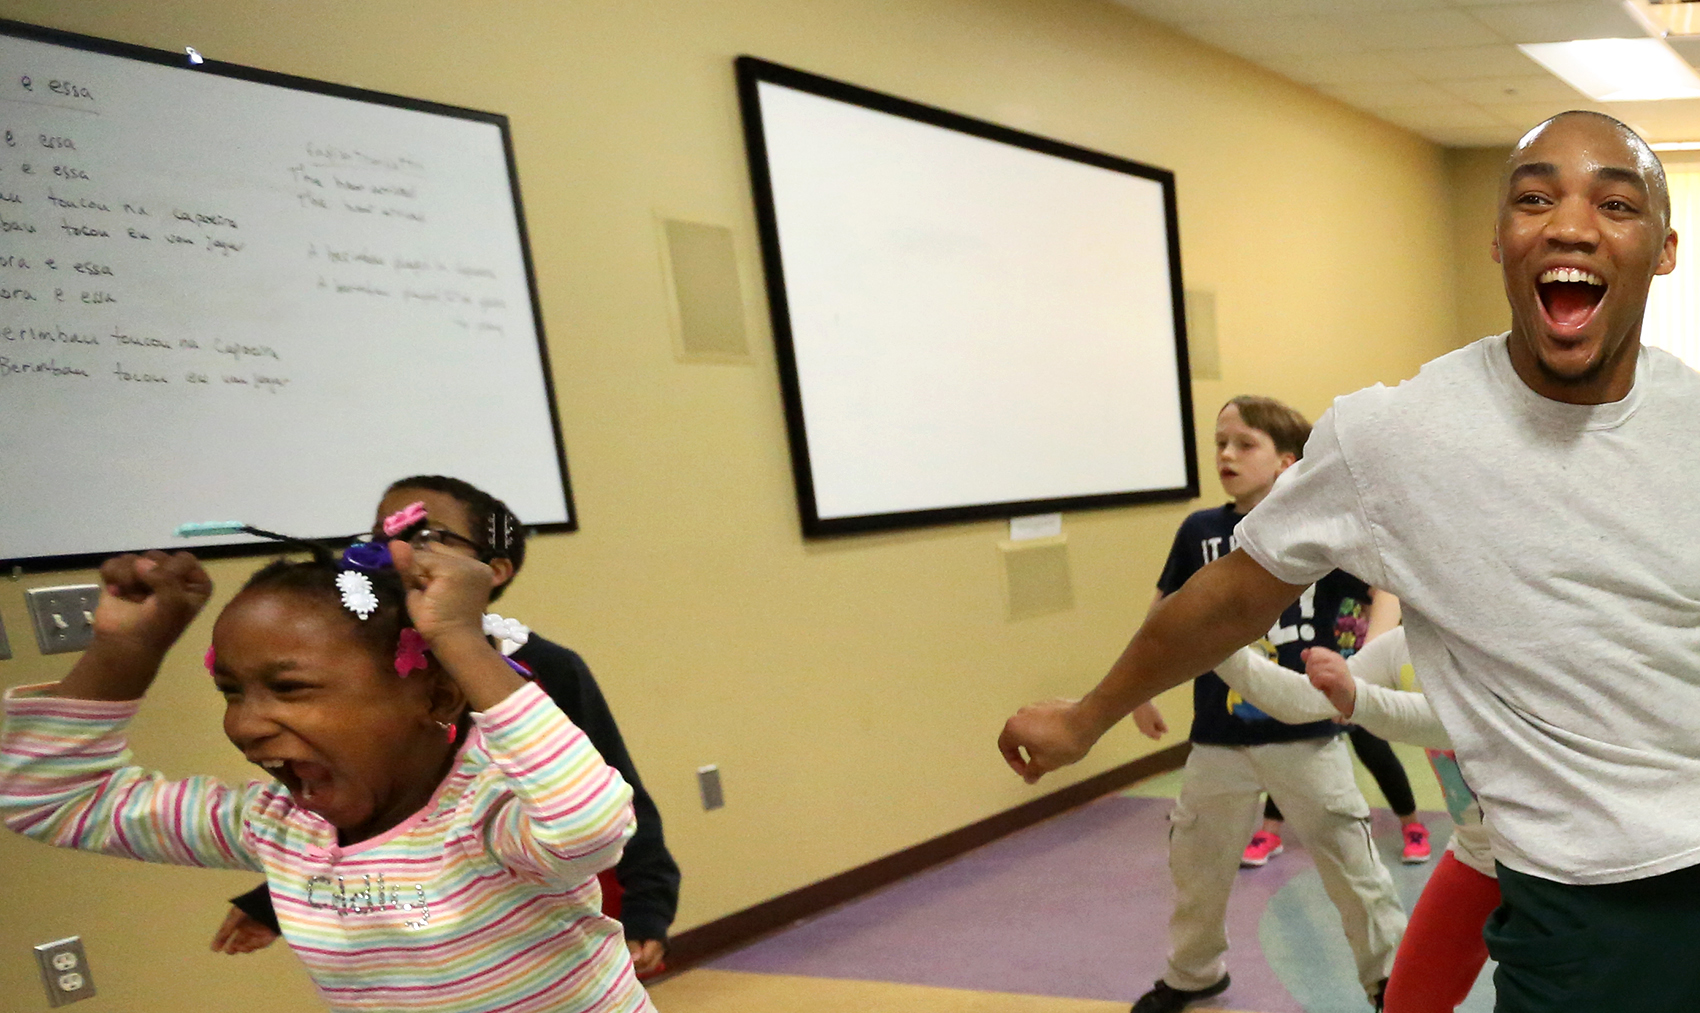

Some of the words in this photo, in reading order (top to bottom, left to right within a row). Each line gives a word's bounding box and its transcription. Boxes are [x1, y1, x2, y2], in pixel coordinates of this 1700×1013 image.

[21, 75, 33, 91] e
[49, 79, 94, 101] essa
[5, 130, 16, 148] e
[39, 133, 76, 151] essa
[53, 165, 90, 181] essa
[45, 258, 58, 270] e
[73, 262, 114, 276] essa
[54, 287, 64, 302] e
[80, 290, 117, 304] essa
